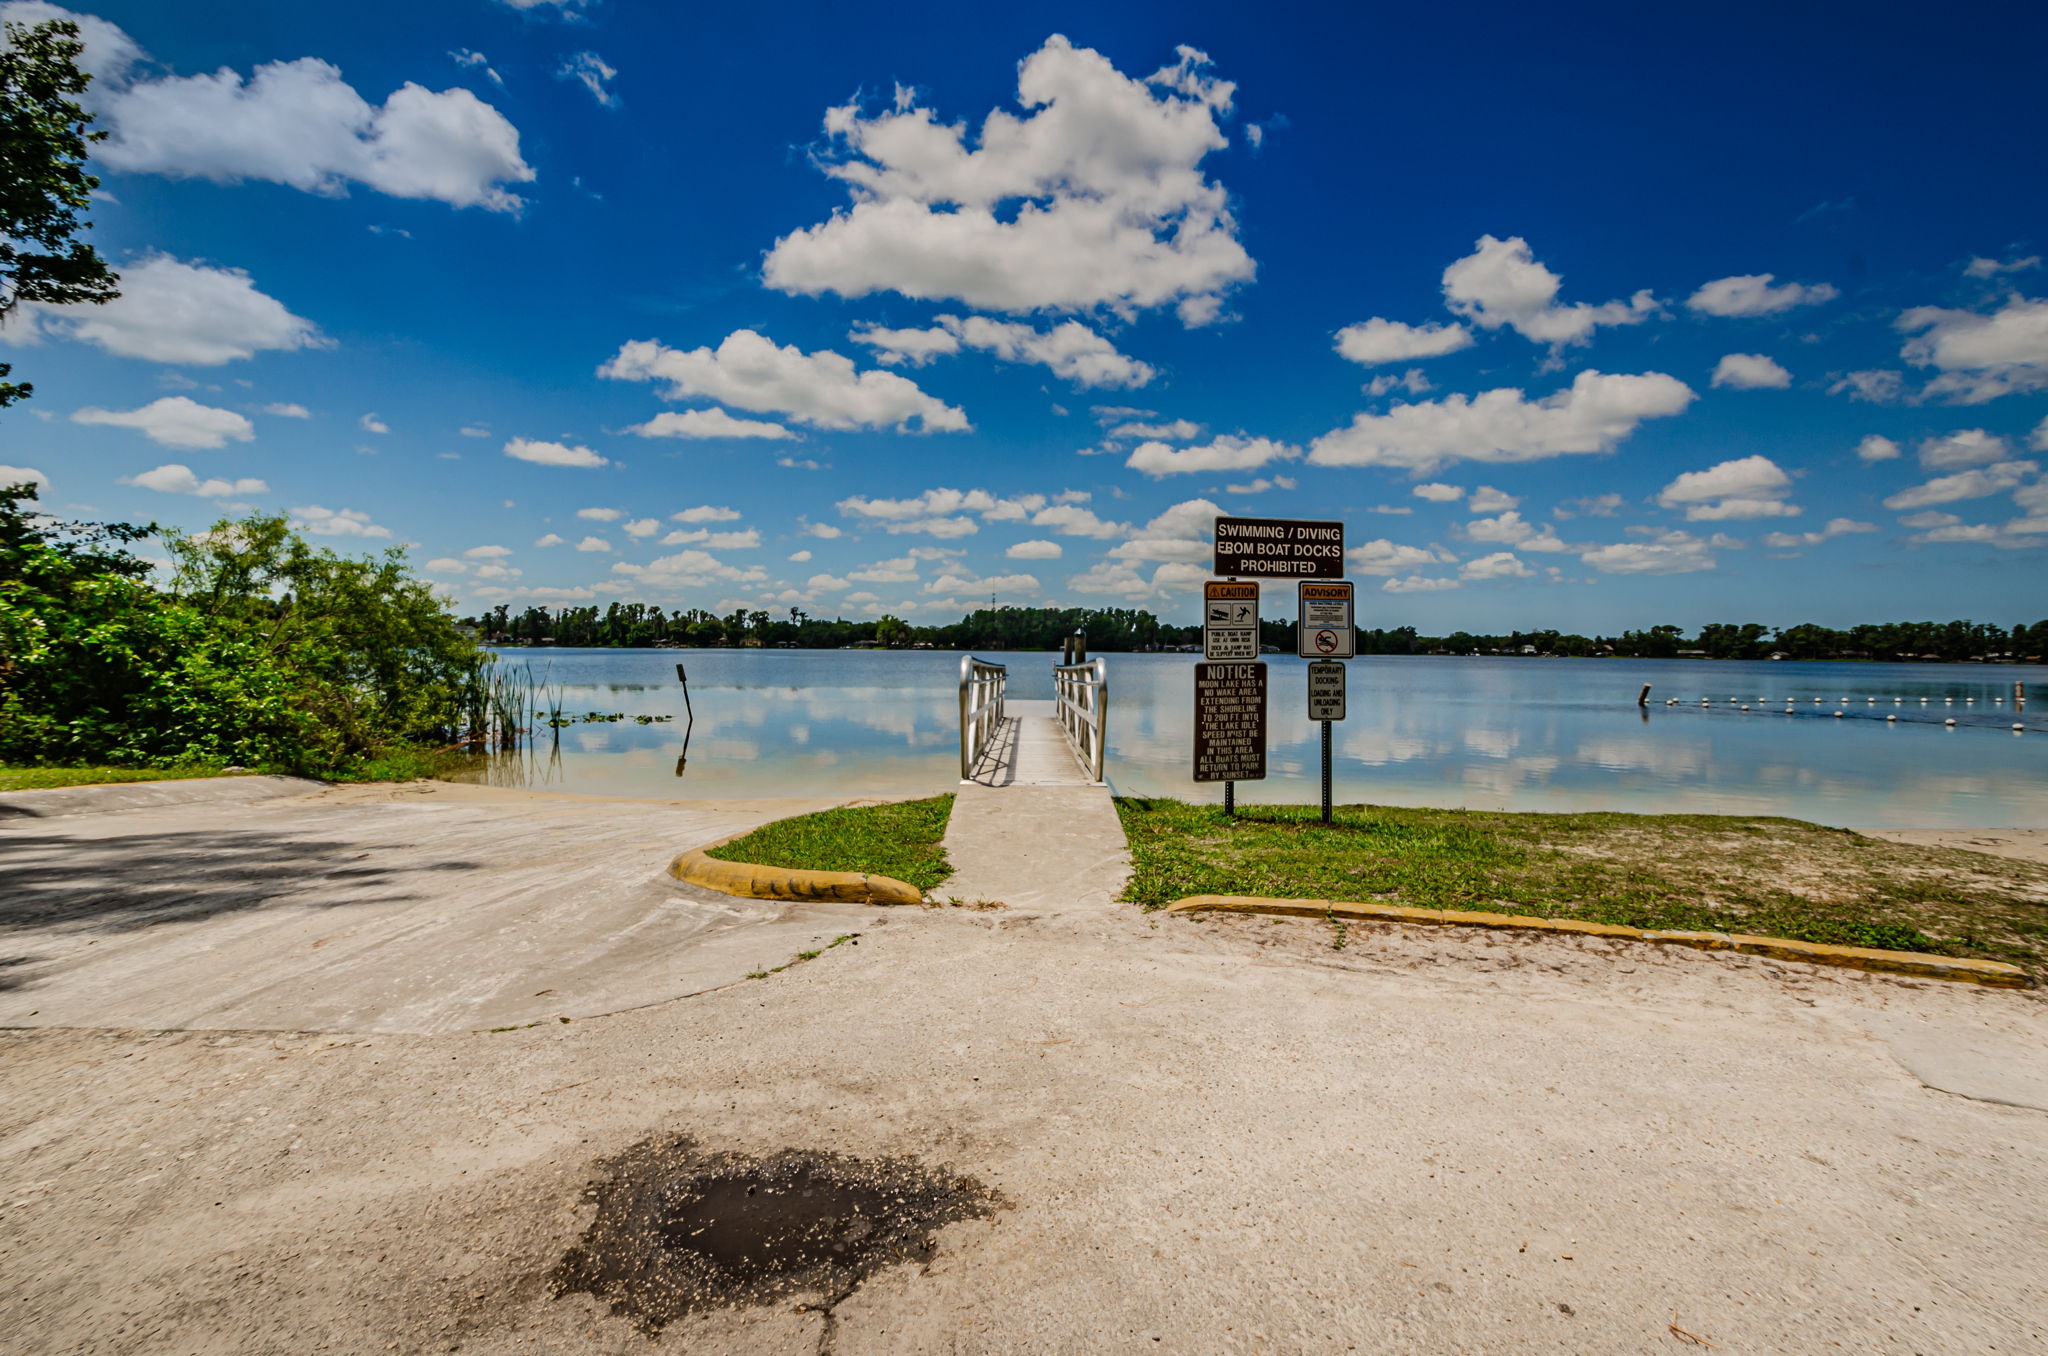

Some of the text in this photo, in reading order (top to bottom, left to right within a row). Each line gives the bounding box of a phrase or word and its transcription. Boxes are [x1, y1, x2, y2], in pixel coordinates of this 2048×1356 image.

[1218, 523, 1341, 541] SWIMMING / DIVING
[1257, 542, 1291, 556] BOAT
[1294, 544, 1341, 558] DOCKS
[1240, 559, 1317, 574] PROHIBITED
[1220, 587, 1255, 598] CAUTION
[1304, 587, 1349, 598] ADVISORY
[1207, 665, 1255, 680] NOTICE
[1311, 666, 1343, 675] TEMPORARY
[1199, 680, 1219, 688] MOON
[1221, 680, 1239, 688] LAKE
[1315, 676, 1339, 684] DOCKING
[1311, 689, 1331, 697] LOADING
[1201, 696, 1261, 705] EXTENDING FROM
[1314, 698, 1340, 706] UNLOADING
[1220, 705, 1257, 713] SHORELINE
[1320, 707, 1333, 716] ONLY
[1203, 714, 1212, 722] TO
[1243, 713, 1259, 721] INTO
[1205, 722, 1218, 730] THE
[1202, 730, 1225, 739] SPEED
[1227, 730, 1247, 738] MUST
[1209, 738, 1251, 746] MAINTAINED
[1235, 746, 1253, 754] AREA
[1216, 755, 1238, 763] BOATS
[1200, 764, 1228, 772] RETURN
[1242, 762, 1259, 770] PARK
[1211, 772, 1219, 780] BY
[1222, 771, 1249, 779] SUNSET
